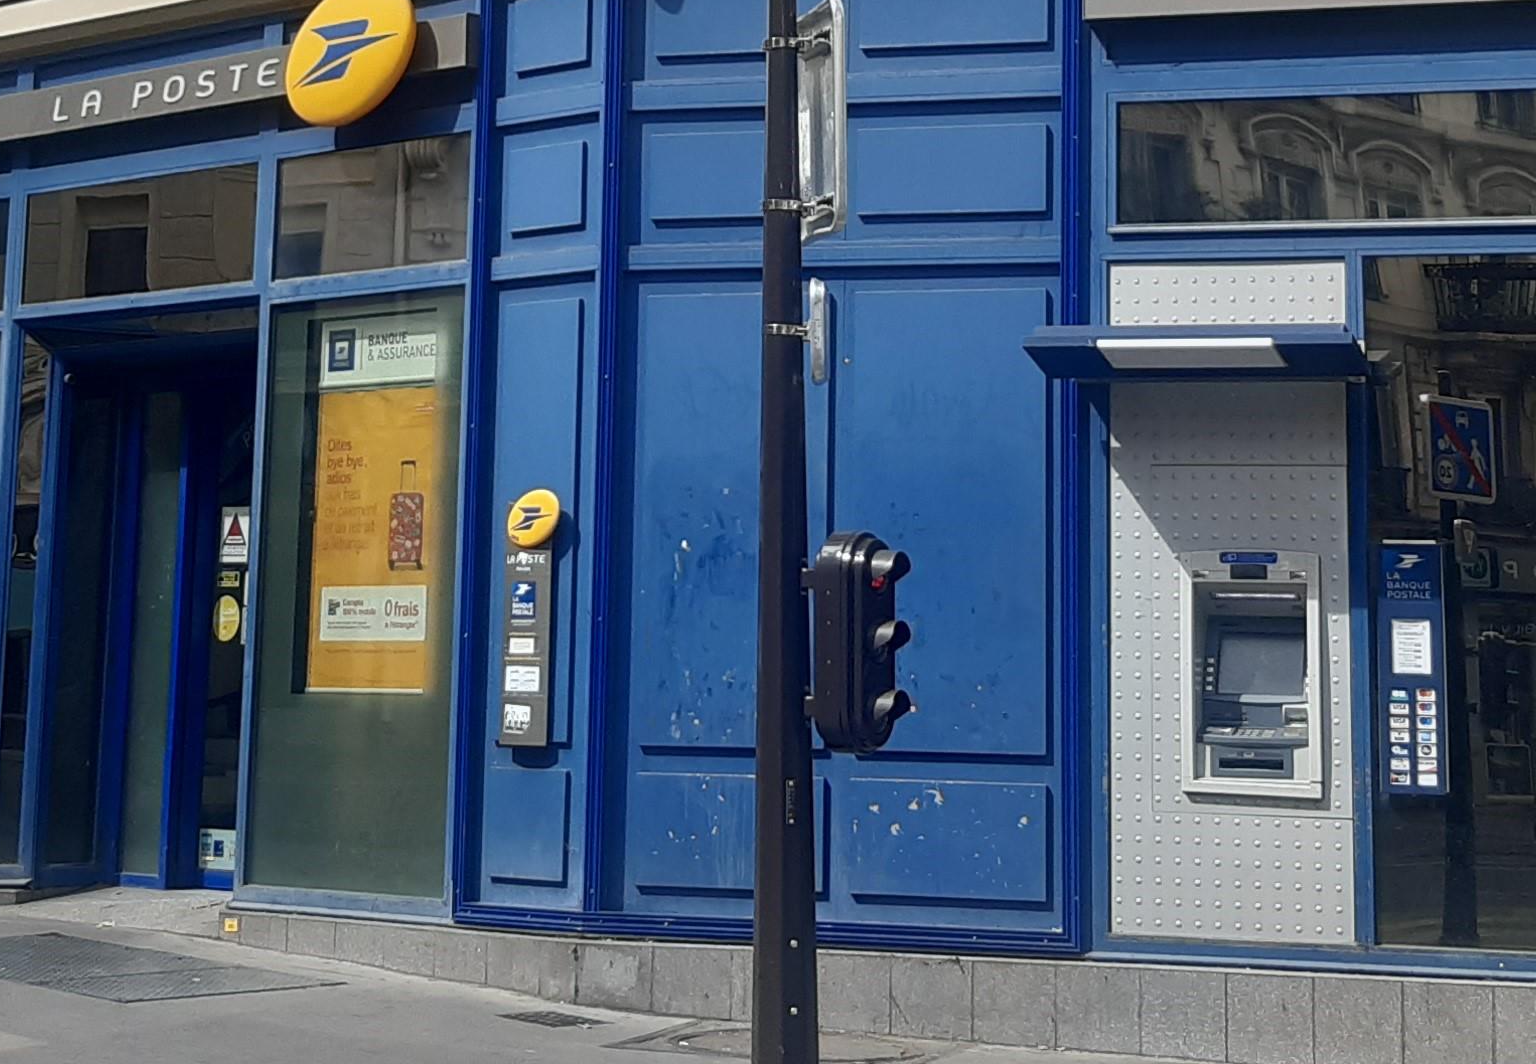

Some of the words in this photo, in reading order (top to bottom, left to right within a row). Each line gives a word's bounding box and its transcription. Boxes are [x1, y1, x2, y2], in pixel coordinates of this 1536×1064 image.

[52, 89, 102, 122] LA
[132, 58, 280, 109] POSTE
[368, 332, 408, 346] BANQUE
[368, 349, 374, 361] &
[377, 344, 437, 360] ASSURANCE
[1386, 571, 1400, 579] LA
[1386, 581, 1431, 590] BANQUE
[1387, 590, 1432, 599] POSTALE
[394, 601, 420, 616] frais
